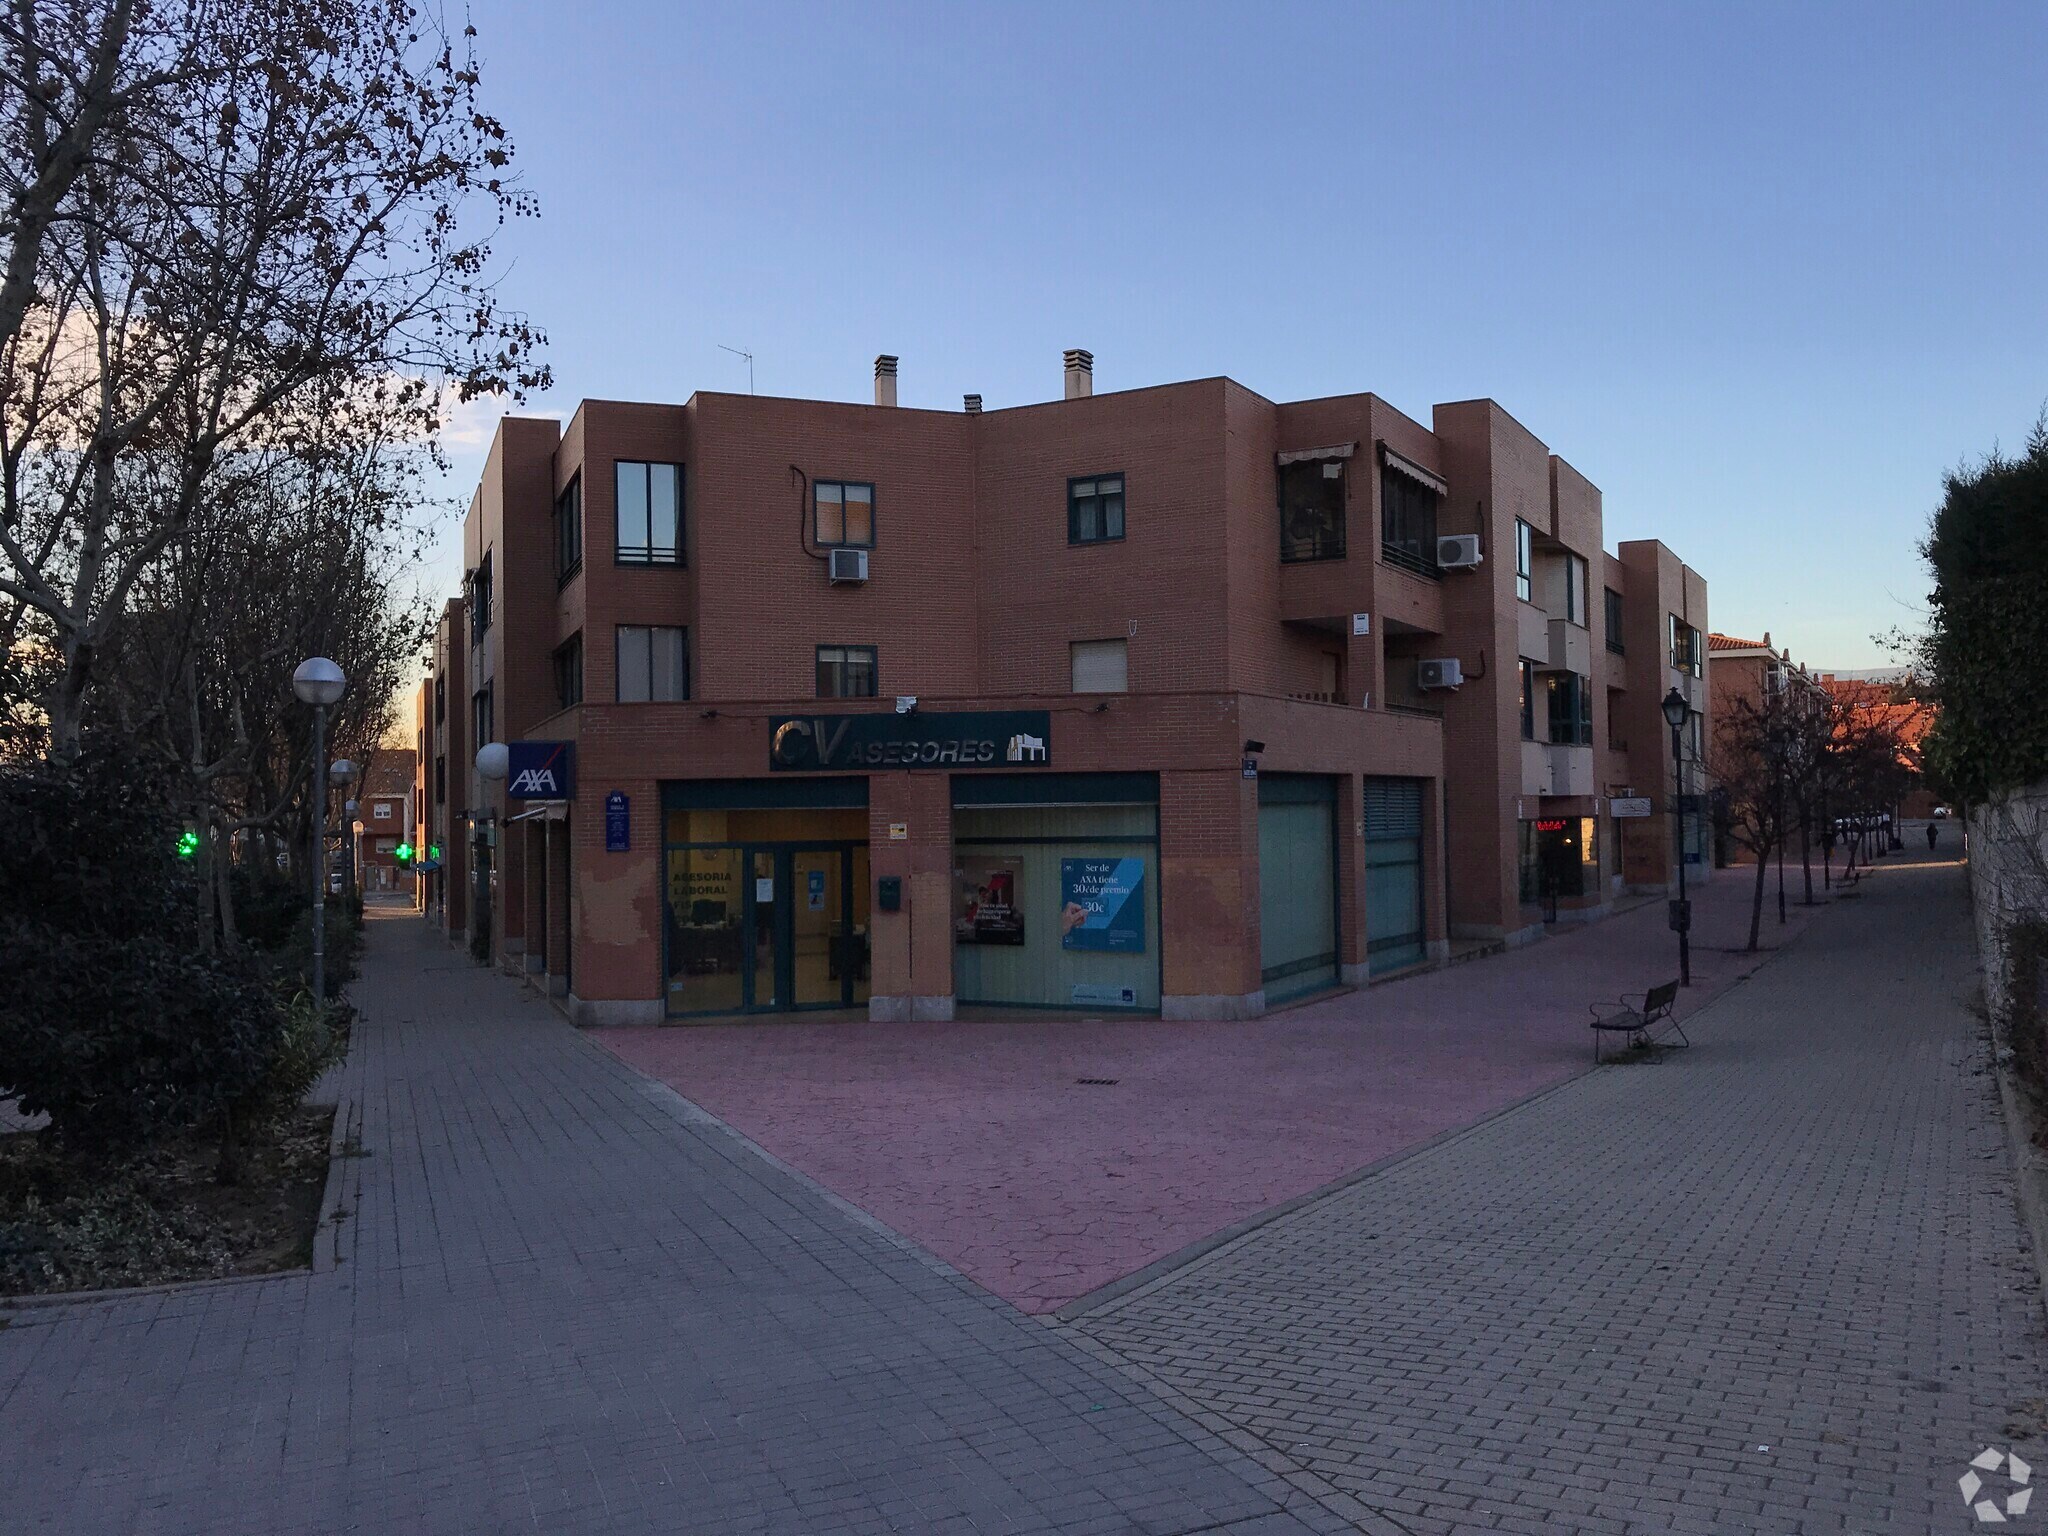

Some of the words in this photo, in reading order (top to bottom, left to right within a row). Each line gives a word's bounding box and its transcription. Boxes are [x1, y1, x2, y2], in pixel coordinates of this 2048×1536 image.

[772, 719, 851, 765] CV
[848, 740, 996, 764] ASESORES
[509, 768, 558, 793] AXA
[1085, 864, 1099, 872] Ser
[1100, 864, 1110, 872] de
[673, 872, 732, 882] ASESORIA
[1080, 876, 1098, 884] AXA
[1099, 876, 1119, 884] tiene
[674, 886, 728, 895] LABORAL
[1101, 886, 1129, 895] premio
